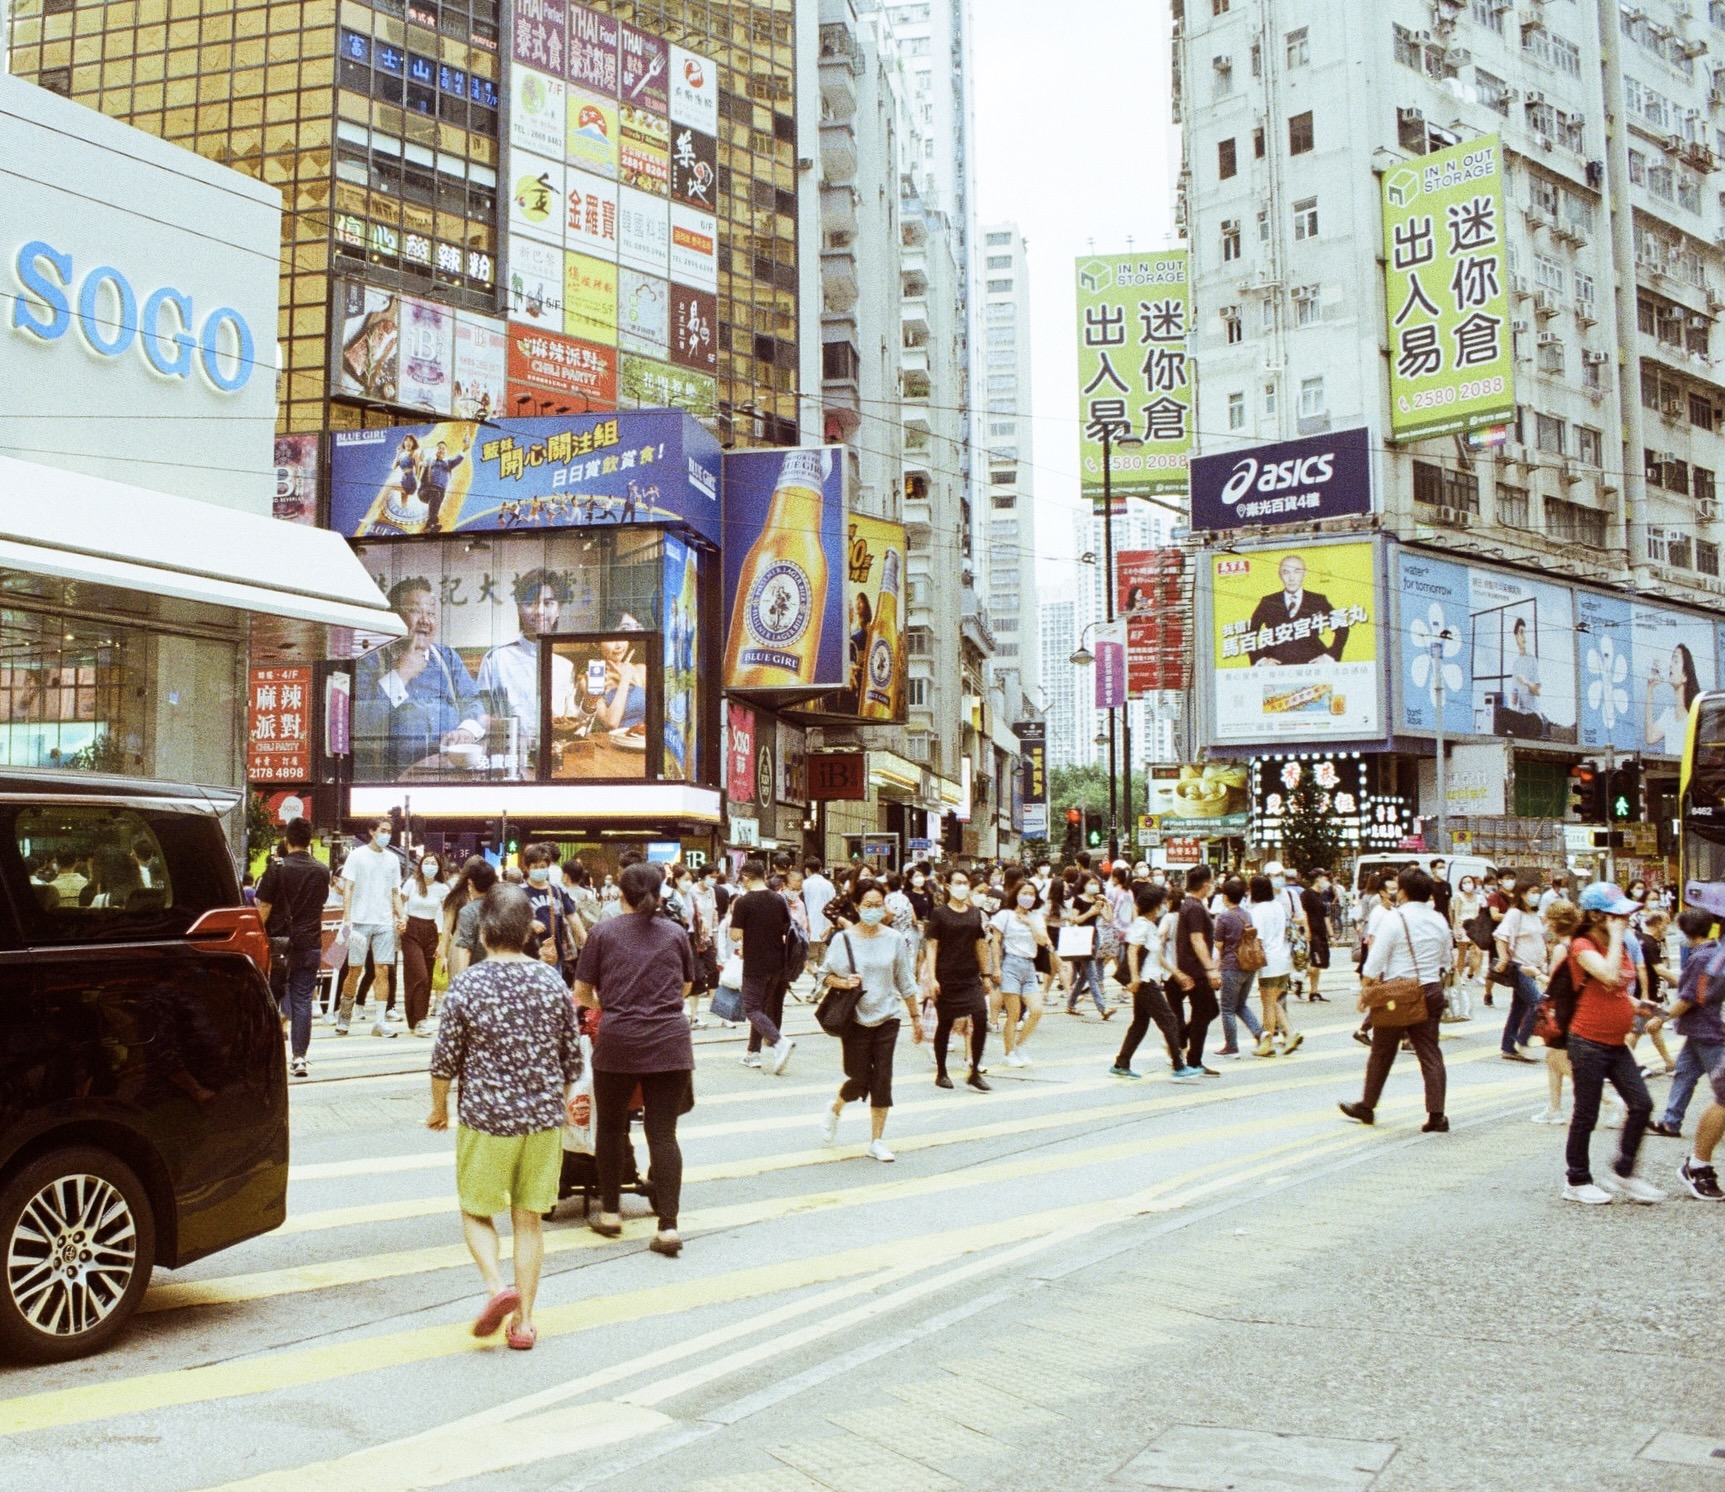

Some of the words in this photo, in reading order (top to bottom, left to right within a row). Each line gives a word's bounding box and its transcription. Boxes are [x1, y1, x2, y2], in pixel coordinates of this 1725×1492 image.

[570, 5, 599, 44] THAI
[622, 29, 643, 56] THAI
[349, 35, 430, 81] 富士山
[1424, 162, 1494, 193] STORAGE
[1425, 165, 1440, 178] IN
[1446, 162, 1456, 173] N
[1463, 149, 1493, 166] OUT
[1117, 264, 1132, 274] IN
[1139, 263, 1149, 273] N
[1157, 260, 1184, 271] OUT
[1117, 271, 1185, 286] STORAGE
[1448, 197, 1501, 368] 迷你倉
[1395, 217, 1441, 377] 出入易
[13, 241, 255, 391] SOGO
[562, 366, 597, 386] PARTY
[1084, 303, 1131, 443] 出入易
[1139, 299, 1189, 441] 迷你倉
[1414, 387, 1456, 408] 2580
[1460, 377, 1503, 399] 2088
[336, 431, 361, 441] BLUE
[363, 430, 386, 440] GIRL
[499, 418, 621, 481] 開心關注組
[1101, 455, 1142, 470] 580
[1258, 452, 1334, 492] asics
[1246, 492, 1320, 517] 崇光百貨4樓
[1222, 604, 1368, 659] 馬百良安宮牛黃丸
[744, 652, 771, 662] BLUE
[772, 655, 798, 668] GIRL
[281, 670, 298, 680] 4/F
[256, 685, 302, 710] 麻辣
[255, 714, 302, 740] 派對
[275, 743, 300, 751] PARTY
[249, 768, 273, 779] 2178
[275, 768, 304, 779] 4898
